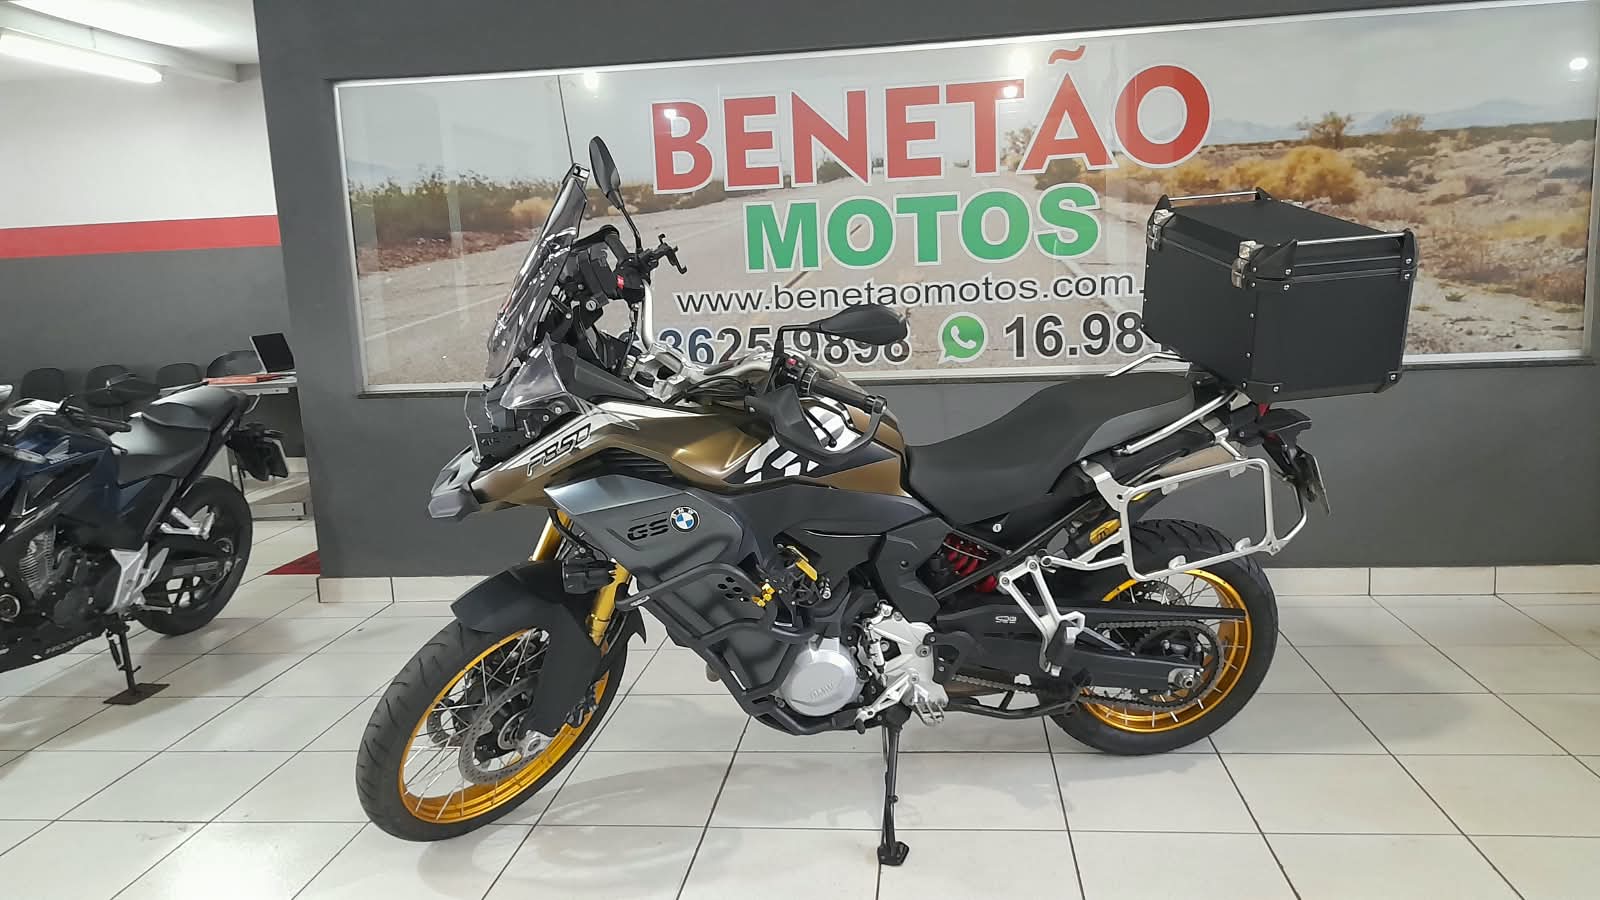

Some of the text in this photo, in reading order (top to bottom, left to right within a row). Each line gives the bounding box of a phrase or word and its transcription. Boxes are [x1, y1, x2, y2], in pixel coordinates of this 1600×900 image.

[651, 45, 1210, 192] BENETÃO
[745, 184, 1099, 270] MOTOS
[526, 423, 592, 477] F850
[627, 518, 669, 541] GS
